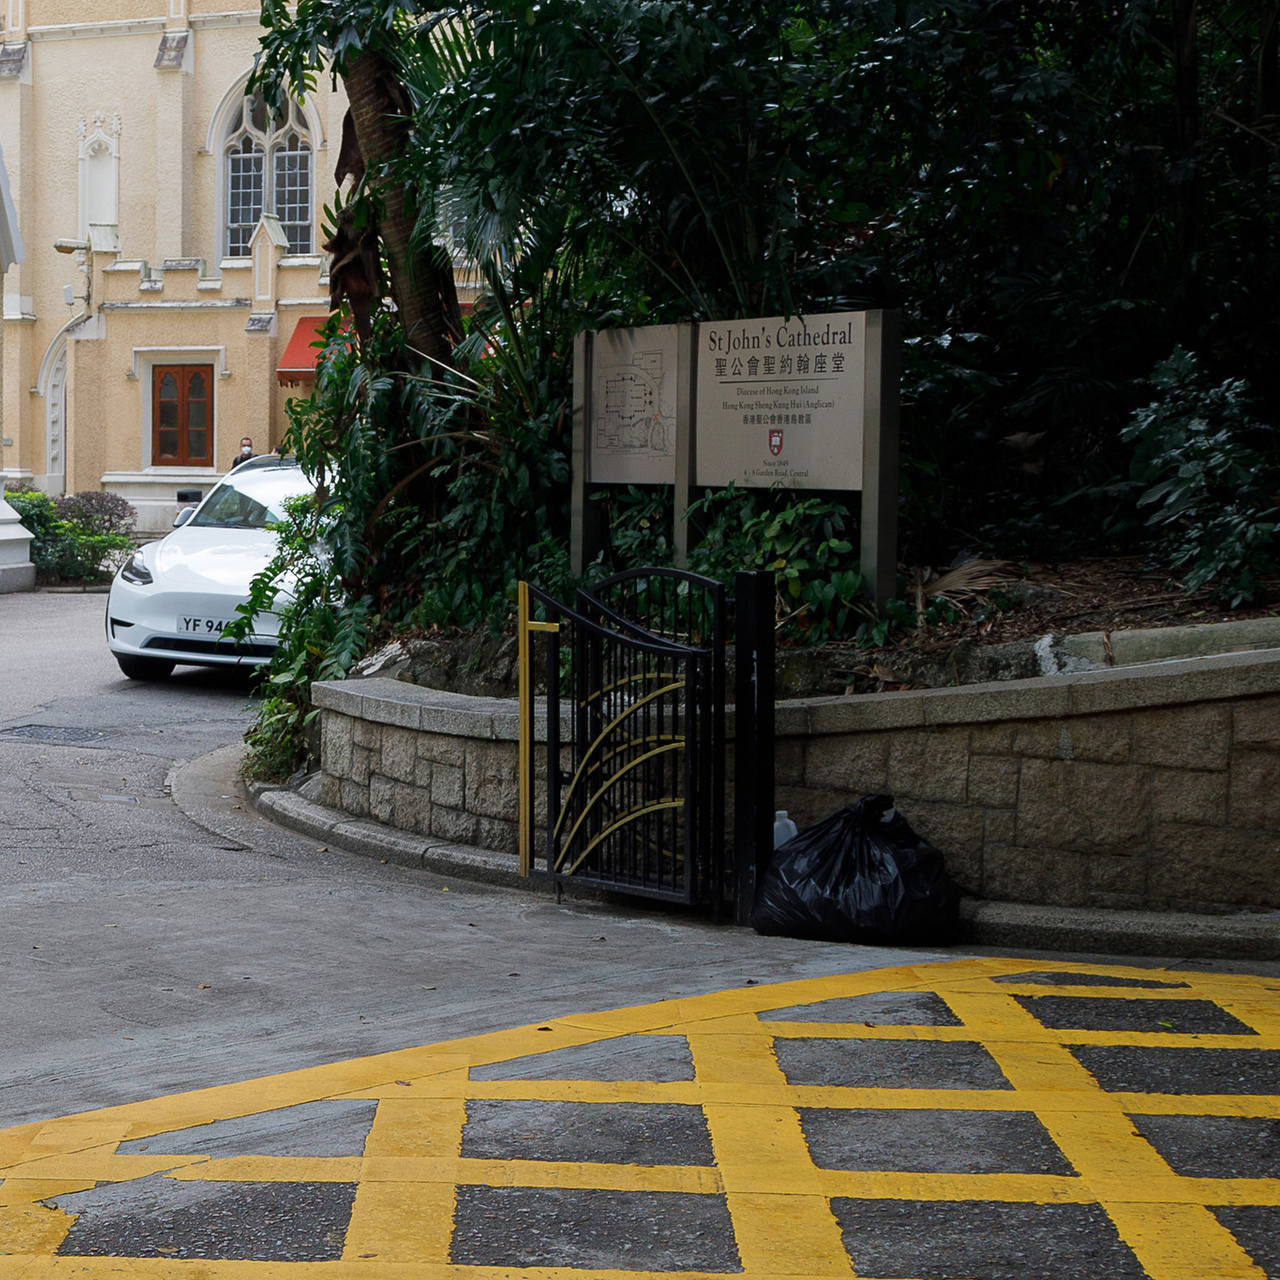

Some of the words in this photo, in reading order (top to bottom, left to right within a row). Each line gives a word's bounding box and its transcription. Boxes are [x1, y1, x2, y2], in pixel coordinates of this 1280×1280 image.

[708, 330, 723, 352] St
[725, 326, 772, 355] John's
[776, 321, 853, 348] Cathedral
[714, 351, 846, 377] 聖公會聖約翰座堂
[736, 387, 759, 396] Diocese
[759, 386, 766, 396] of
[766, 386, 782, 396] Hong
[783, 385, 800, 395] Kong
[800, 385, 819, 395] Island
[722, 401, 738, 410] Hong
[739, 401, 754, 410] Kong
[755, 400, 772, 410] Sheng
[773, 400, 789, 409] Kung
[790, 400, 802, 408] Hui
[803, 399, 835, 409] (Anglican)
[789, 469, 809, 477] Central
[183, 617, 201, 632] YF
